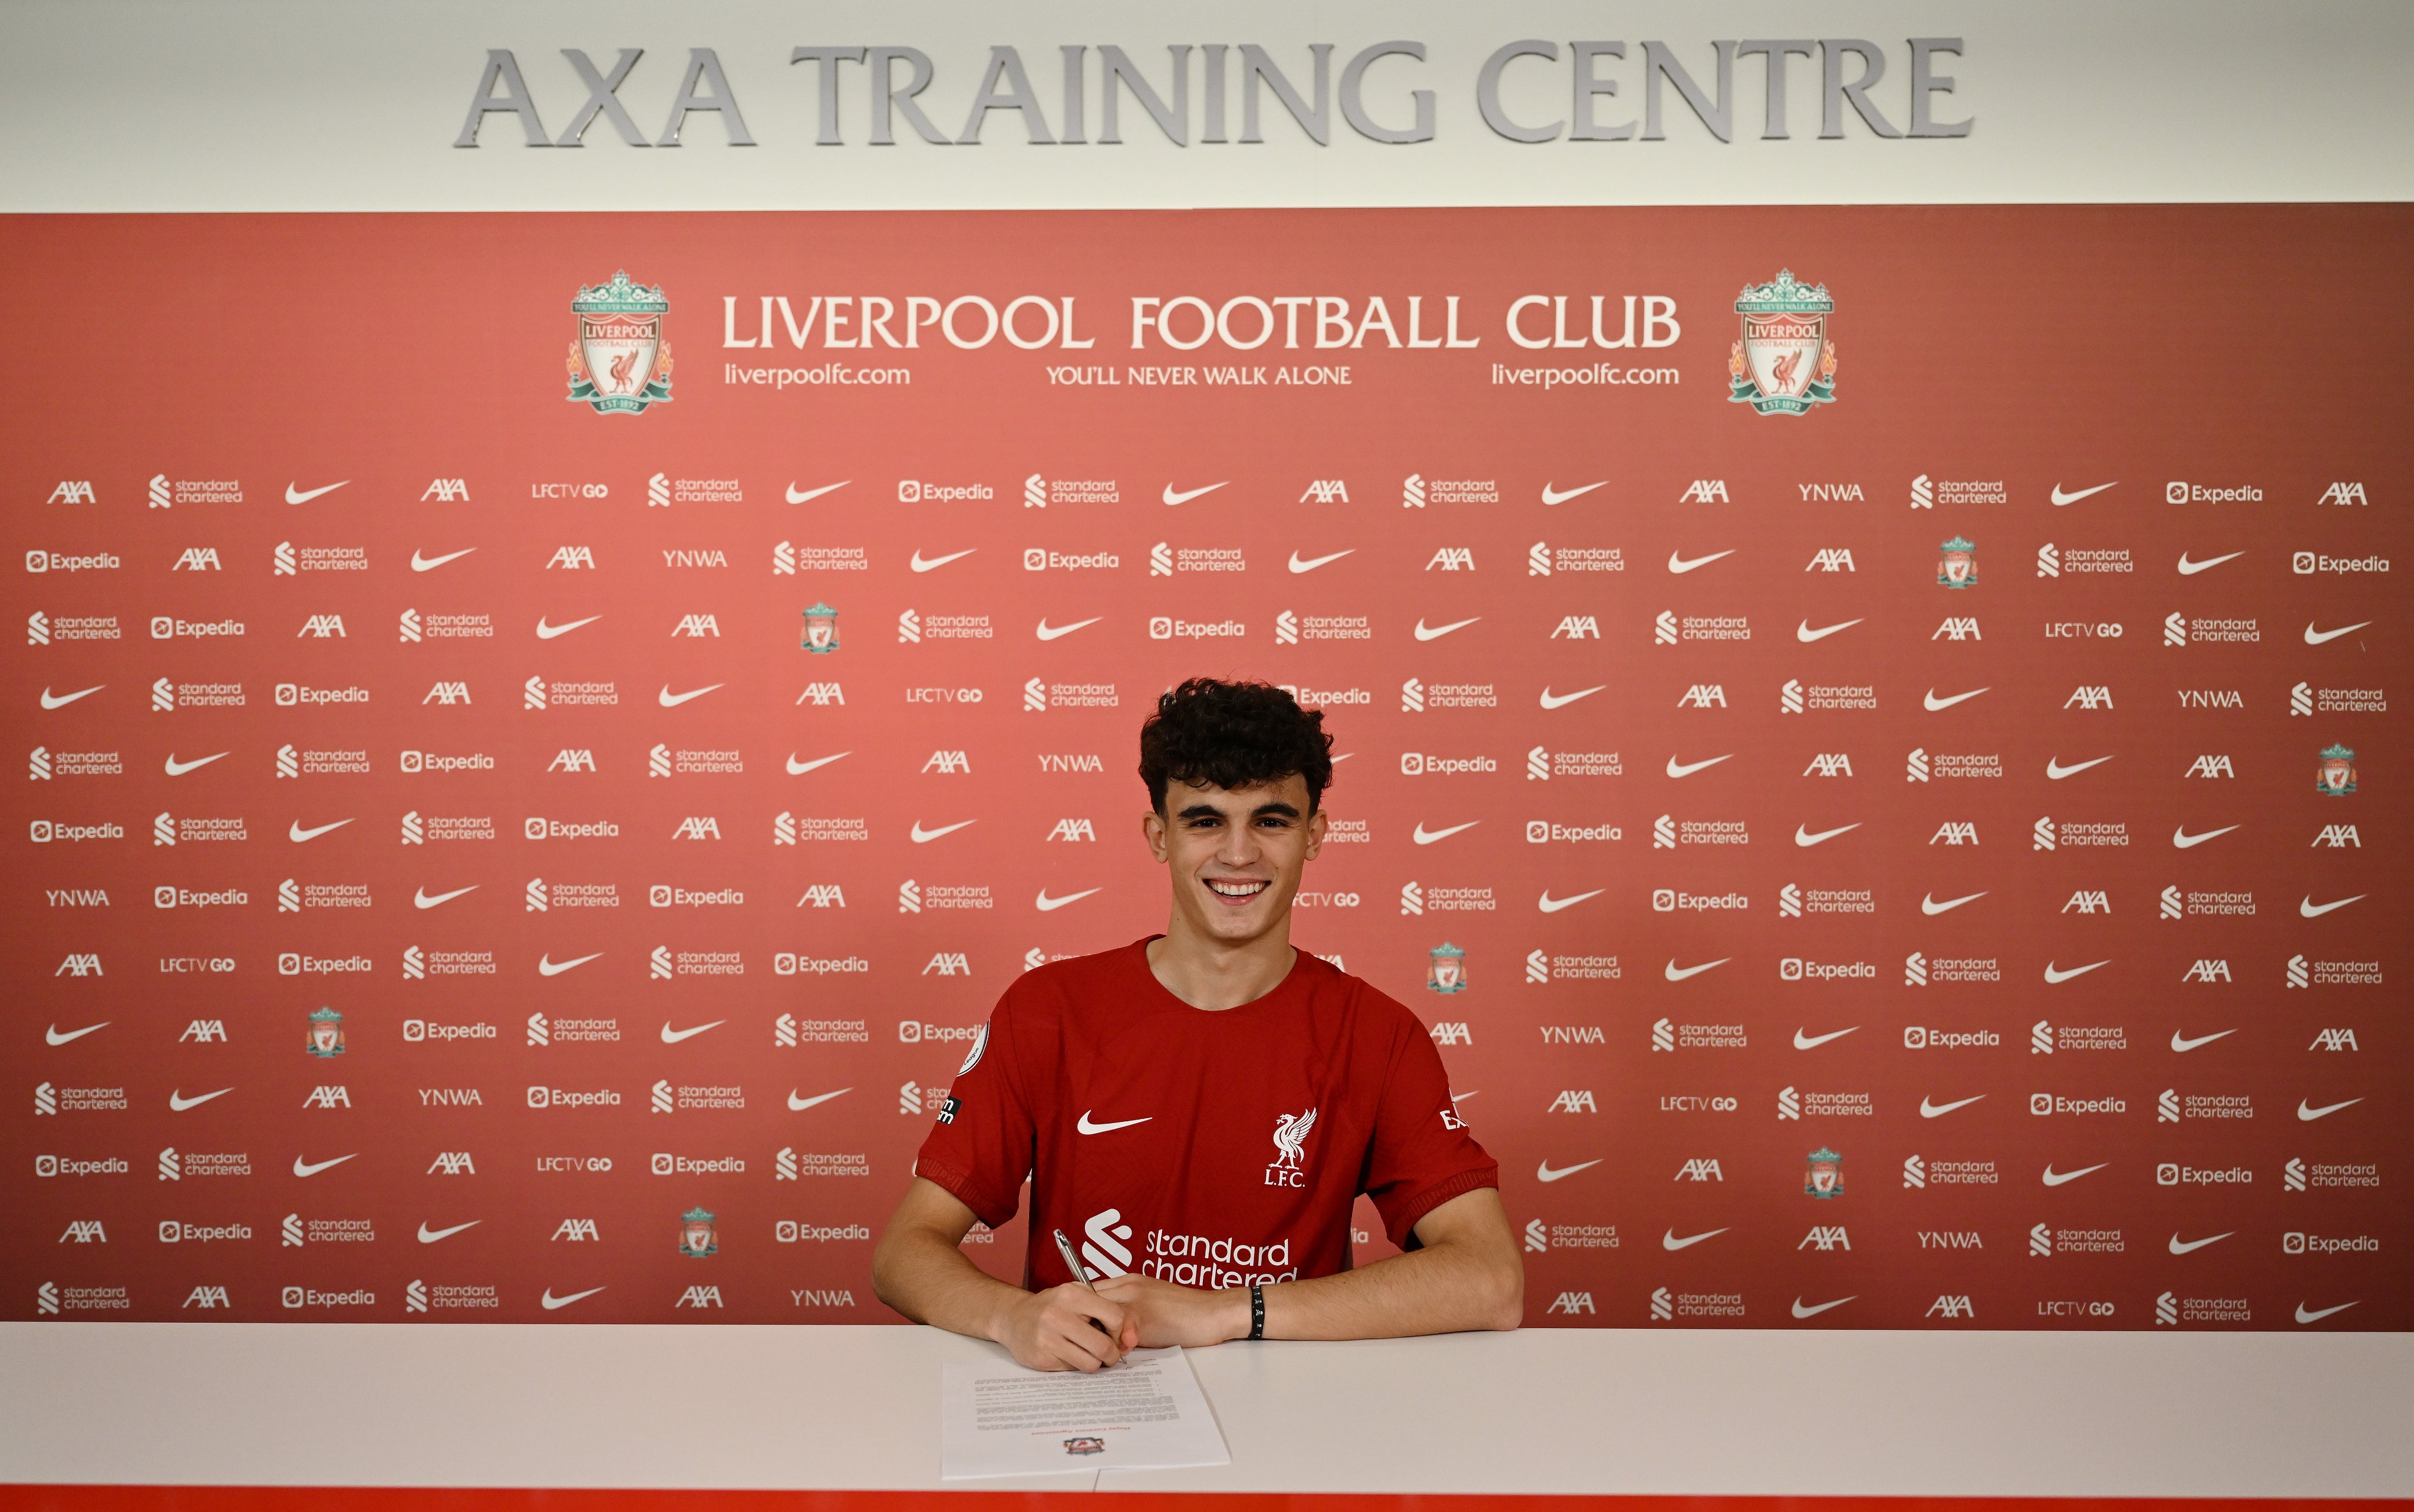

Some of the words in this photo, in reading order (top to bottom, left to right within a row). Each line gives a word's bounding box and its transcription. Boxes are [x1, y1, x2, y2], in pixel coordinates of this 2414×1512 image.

[453, 48, 758, 148] AXA
[792, 40, 1436, 147] TRAINING
[1476, 37, 1975, 144] CENTRE
[585, 325, 655, 338] LIVERPOOL
[723, 295, 1095, 350] LIVERPOOL
[1130, 295, 1480, 350] FOOTBALL
[1506, 295, 1681, 349] CLUB
[1749, 325, 1819, 338] LIVERPOOL
[588, 339, 628, 348] FOOTBALL
[631, 339, 652, 348] CLUB
[725, 363, 911, 390] liverpoolfc.com
[1046, 366, 1120, 385] YOU'LL
[1128, 366, 1198, 385] NEVER
[1203, 366, 1268, 385] WALK
[1274, 366, 1353, 385] ALONE
[1492, 363, 1680, 390] liverpoolfc.com
[47, 481, 97, 504] AXA
[420, 478, 470, 501] AXA
[532, 484, 580, 498] LFCTV
[582, 483, 608, 498] GO
[675, 478, 738, 491] standard
[924, 483, 993, 503] Expedia
[1051, 480, 1115, 492] standard
[1679, 480, 1730, 503] AXA
[1798, 484, 1865, 501] YNWA
[1938, 480, 2003, 493] standard
[675, 490, 742, 501] chartered
[1051, 491, 1119, 503] chartered
[1938, 492, 2006, 504] chartered
[2192, 485, 2263, 504] Expedia
[2317, 482, 2368, 506] AXA
[51, 552, 120, 572] Expedia
[662, 550, 728, 567] YNWA
[1049, 552, 1119, 571] Expedia
[1425, 547, 1475, 571] AXA
[1556, 547, 1620, 560] standard
[1556, 559, 1624, 571] chartered
[2319, 555, 2389, 575] Expedia
[54, 616, 120, 629] standard
[671, 614, 720, 637] AXA
[1175, 620, 1245, 639] Expedia
[1931, 617, 1981, 641] AXA
[2046, 622, 2094, 638] LFCTV
[2097, 623, 2123, 638] GO
[54, 628, 121, 639] chartered
[422, 682, 471, 705] AXA
[551, 682, 614, 694] standard
[906, 688, 955, 702] LFCTV
[957, 688, 982, 702] GO
[1051, 684, 1114, 695] standard
[1677, 684, 1727, 708] AXA
[2319, 688, 2382, 701] standard
[551, 693, 618, 704] chartered
[1051, 695, 1118, 707] chartered
[2063, 686, 2113, 709] AXA
[2178, 690, 2244, 708] YNWA
[2318, 700, 2386, 712] chartered
[426, 753, 494, 772] Expedia
[921, 750, 971, 773] AXA
[1038, 754, 1103, 772] YNWA
[55, 822, 124, 842] Expedia
[1046, 818, 1096, 841] AXA
[1552, 824, 1622, 843] Expedia
[1928, 822, 1979, 845] AXA
[2061, 823, 2125, 835] standard
[2310, 824, 2361, 847] AXA
[2061, 834, 2129, 846] chartered
[45, 889, 110, 907] YNWA
[305, 884, 367, 896] standard
[675, 889, 743, 907] Expedia
[797, 884, 846, 907] AXA
[1429, 887, 1492, 900] standard
[1807, 889, 1870, 902] standard
[305, 896, 371, 907] chartered
[1334, 892, 1360, 907] GO
[1428, 899, 1496, 910] chartered
[1678, 893, 1748, 912] Expedia
[1806, 902, 1874, 913] chartered
[2061, 890, 2111, 914] AXA
[55, 953, 104, 976] AXA
[160, 958, 208, 972] LFCTV
[210, 958, 236, 972] GO
[678, 952, 740, 964] standard
[799, 956, 868, 975] Expedia
[2314, 960, 2378, 973] standard
[677, 963, 744, 974] chartered
[1806, 962, 1875, 981] Expedia
[2314, 972, 2382, 983] chartered
[428, 1022, 497, 1042] Expedia
[924, 1024, 982, 1043] Expedi
[1429, 1022, 1472, 1045] AXA
[1540, 1026, 1605, 1044] YNWA
[2309, 1028, 2359, 1051] AXA
[418, 1089, 483, 1106] YNWA
[1661, 1097, 1709, 1111] LFCTV
[1711, 1097, 1737, 1112] GO
[2056, 1097, 2126, 1116] Expedia
[60, 1157, 128, 1177] Expedia
[426, 1152, 476, 1174] AXA
[537, 1157, 585, 1171] LFCTV
[586, 1157, 612, 1171] GO
[803, 1153, 865, 1166] standard
[1931, 1161, 1994, 1173] standard
[802, 1165, 869, 1176] chartered
[1264, 1168, 1305, 1187] L.F.C.
[1673, 1158, 1724, 1182] AXA
[1931, 1173, 1998, 1183] chartered
[2182, 1167, 2252, 1186] Expedia
[2312, 1164, 2375, 1176] standard
[2312, 1175, 2379, 1186] chartered
[58, 1220, 107, 1243] AXA
[800, 1224, 869, 1243] Expedia
[1552, 1225, 1615, 1237] standard
[1146, 1229, 1289, 1266] standard
[1552, 1237, 1619, 1247] chartered
[1917, 1232, 1983, 1249] YNWA
[2309, 1235, 2379, 1255] Expedia
[1142, 1256, 1298, 1290] chartered
[64, 1287, 126, 1298] standard
[307, 1289, 375, 1308] Expedia
[433, 1285, 494, 1297] standard
[675, 1286, 724, 1308] AXA
[791, 1290, 855, 1306] YNWA
[64, 1298, 130, 1309] chartered
[433, 1296, 499, 1307] chartered
[1548, 1292, 1596, 1315] AXA
[1925, 1295, 1974, 1318] AXA
[2039, 1302, 2086, 1315] LFCTV
[2089, 1302, 2115, 1316] GO
